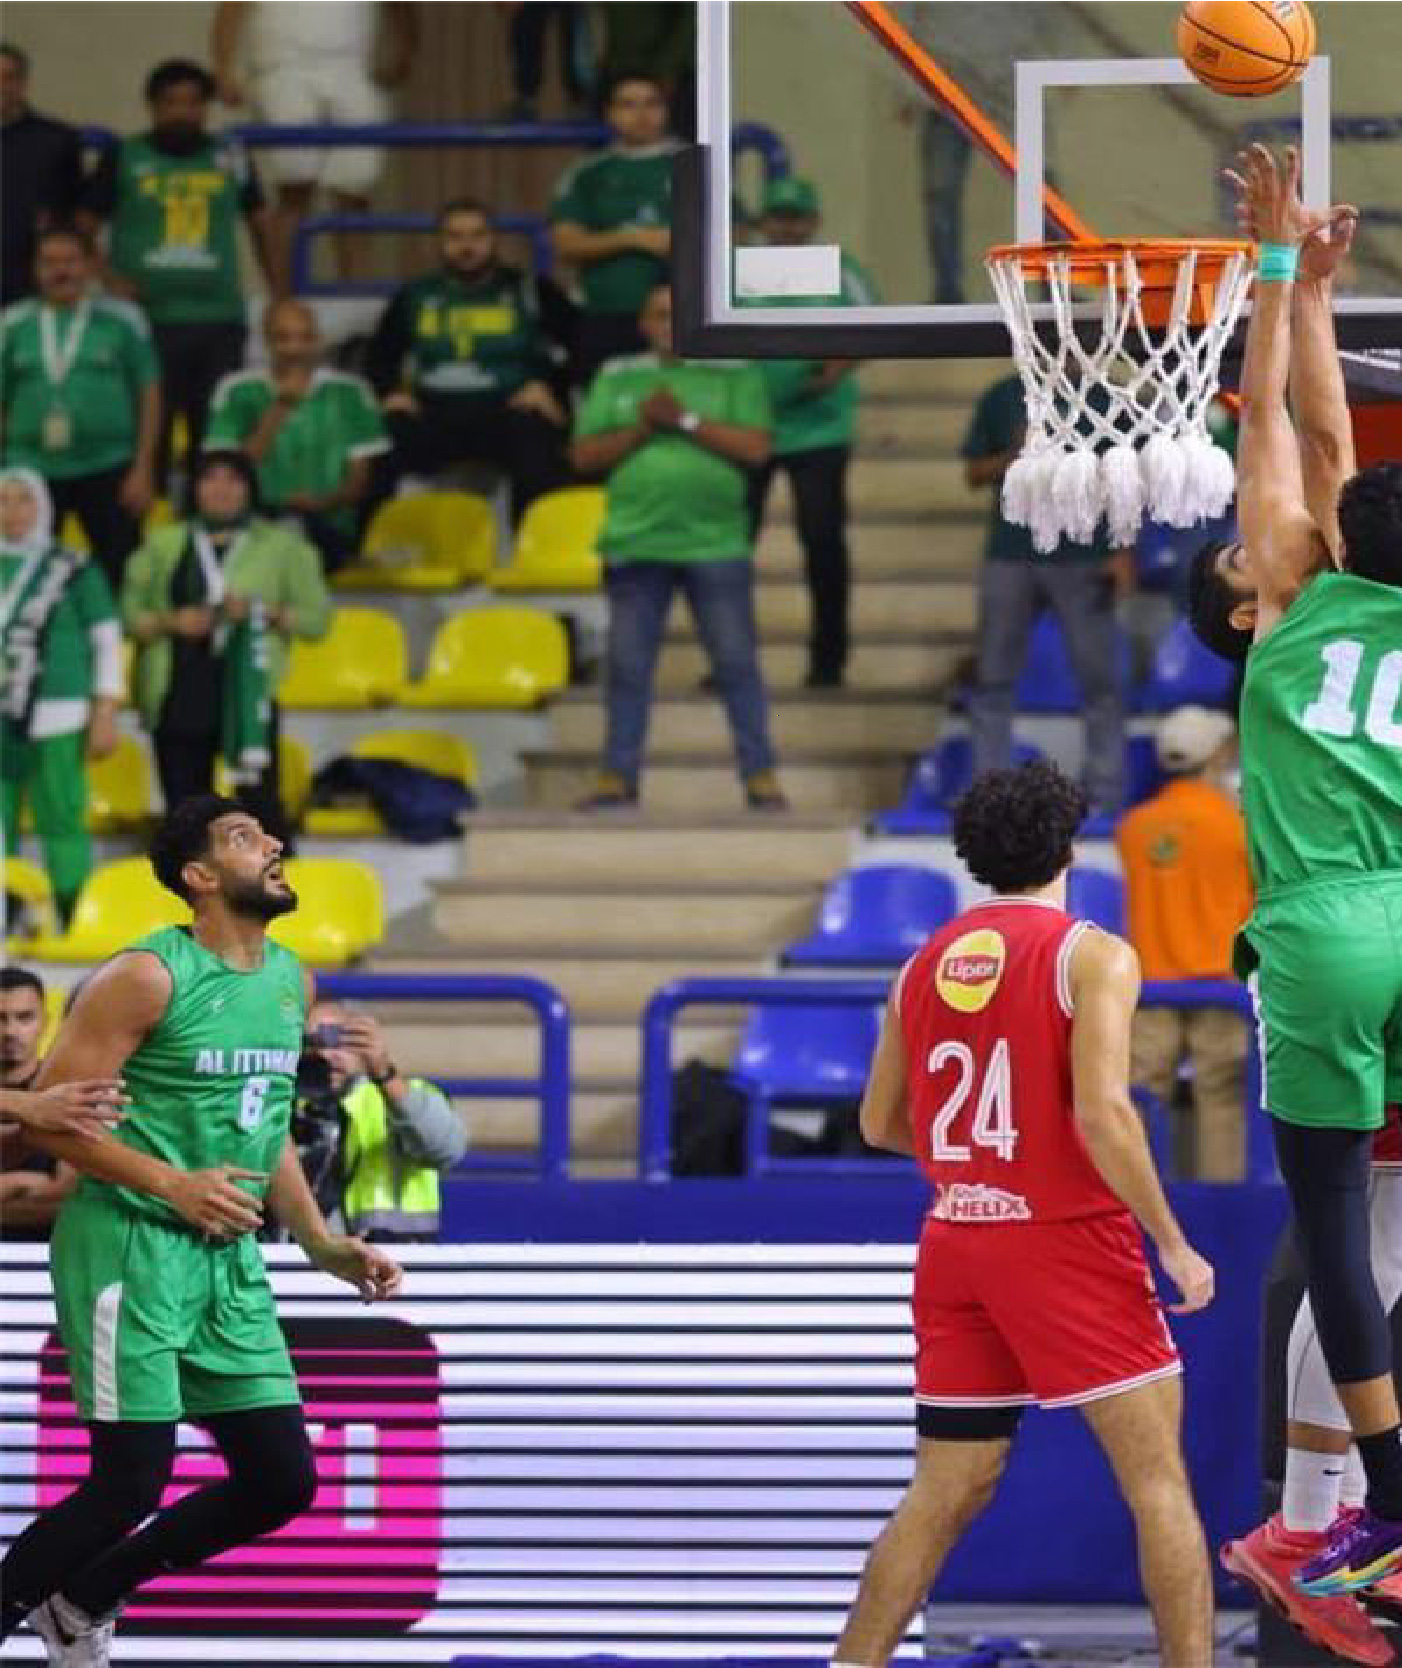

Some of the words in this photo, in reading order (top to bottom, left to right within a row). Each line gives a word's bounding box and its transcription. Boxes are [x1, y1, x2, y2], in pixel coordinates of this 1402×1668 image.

[195, 1050, 227, 1074] AL
[232, 1048, 299, 1076] ITTIHA
[239, 1075, 268, 1128] 6
[928, 1037, 1019, 1162] 24
[951, 1199, 1021, 1218] HELIX
